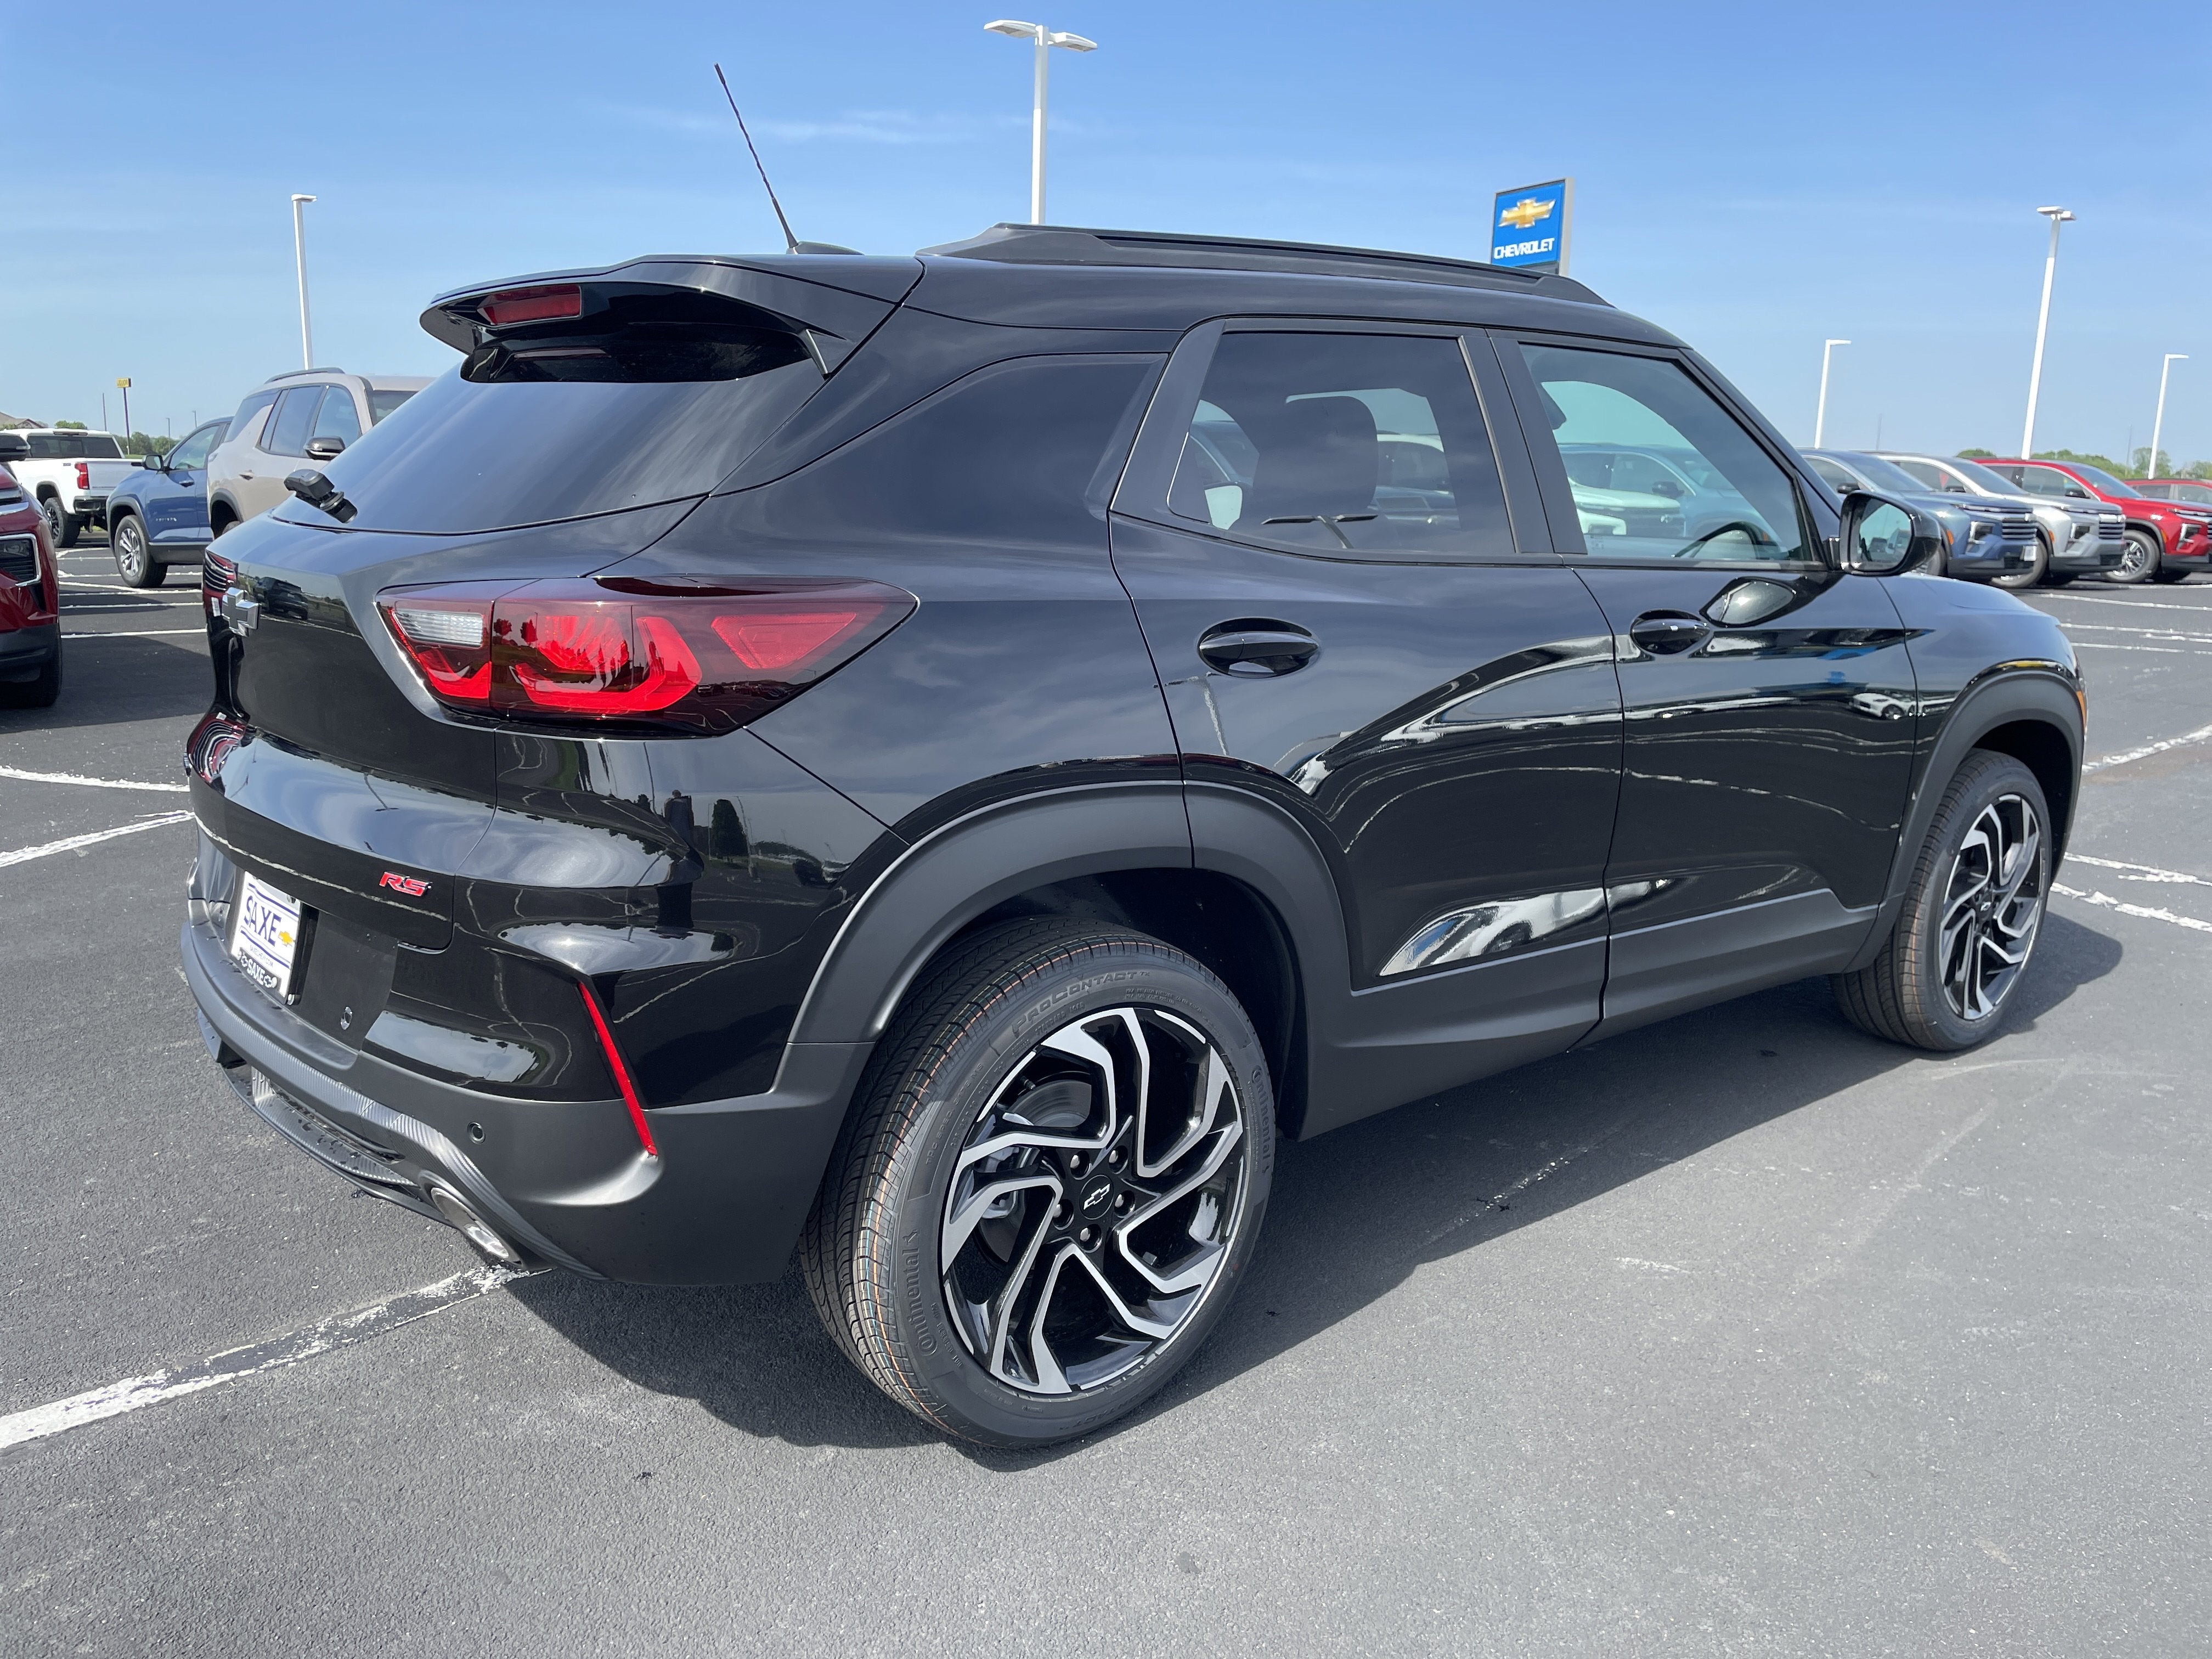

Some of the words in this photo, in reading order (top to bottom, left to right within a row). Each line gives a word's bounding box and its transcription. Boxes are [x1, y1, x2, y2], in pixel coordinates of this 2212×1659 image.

[1493, 238, 1555, 259] CHEVROLET
[379, 871, 430, 896] RS
[244, 895, 282, 947] SAXE
[247, 958, 266, 986] SAXE
[902, 1247, 938, 1356] Continental
